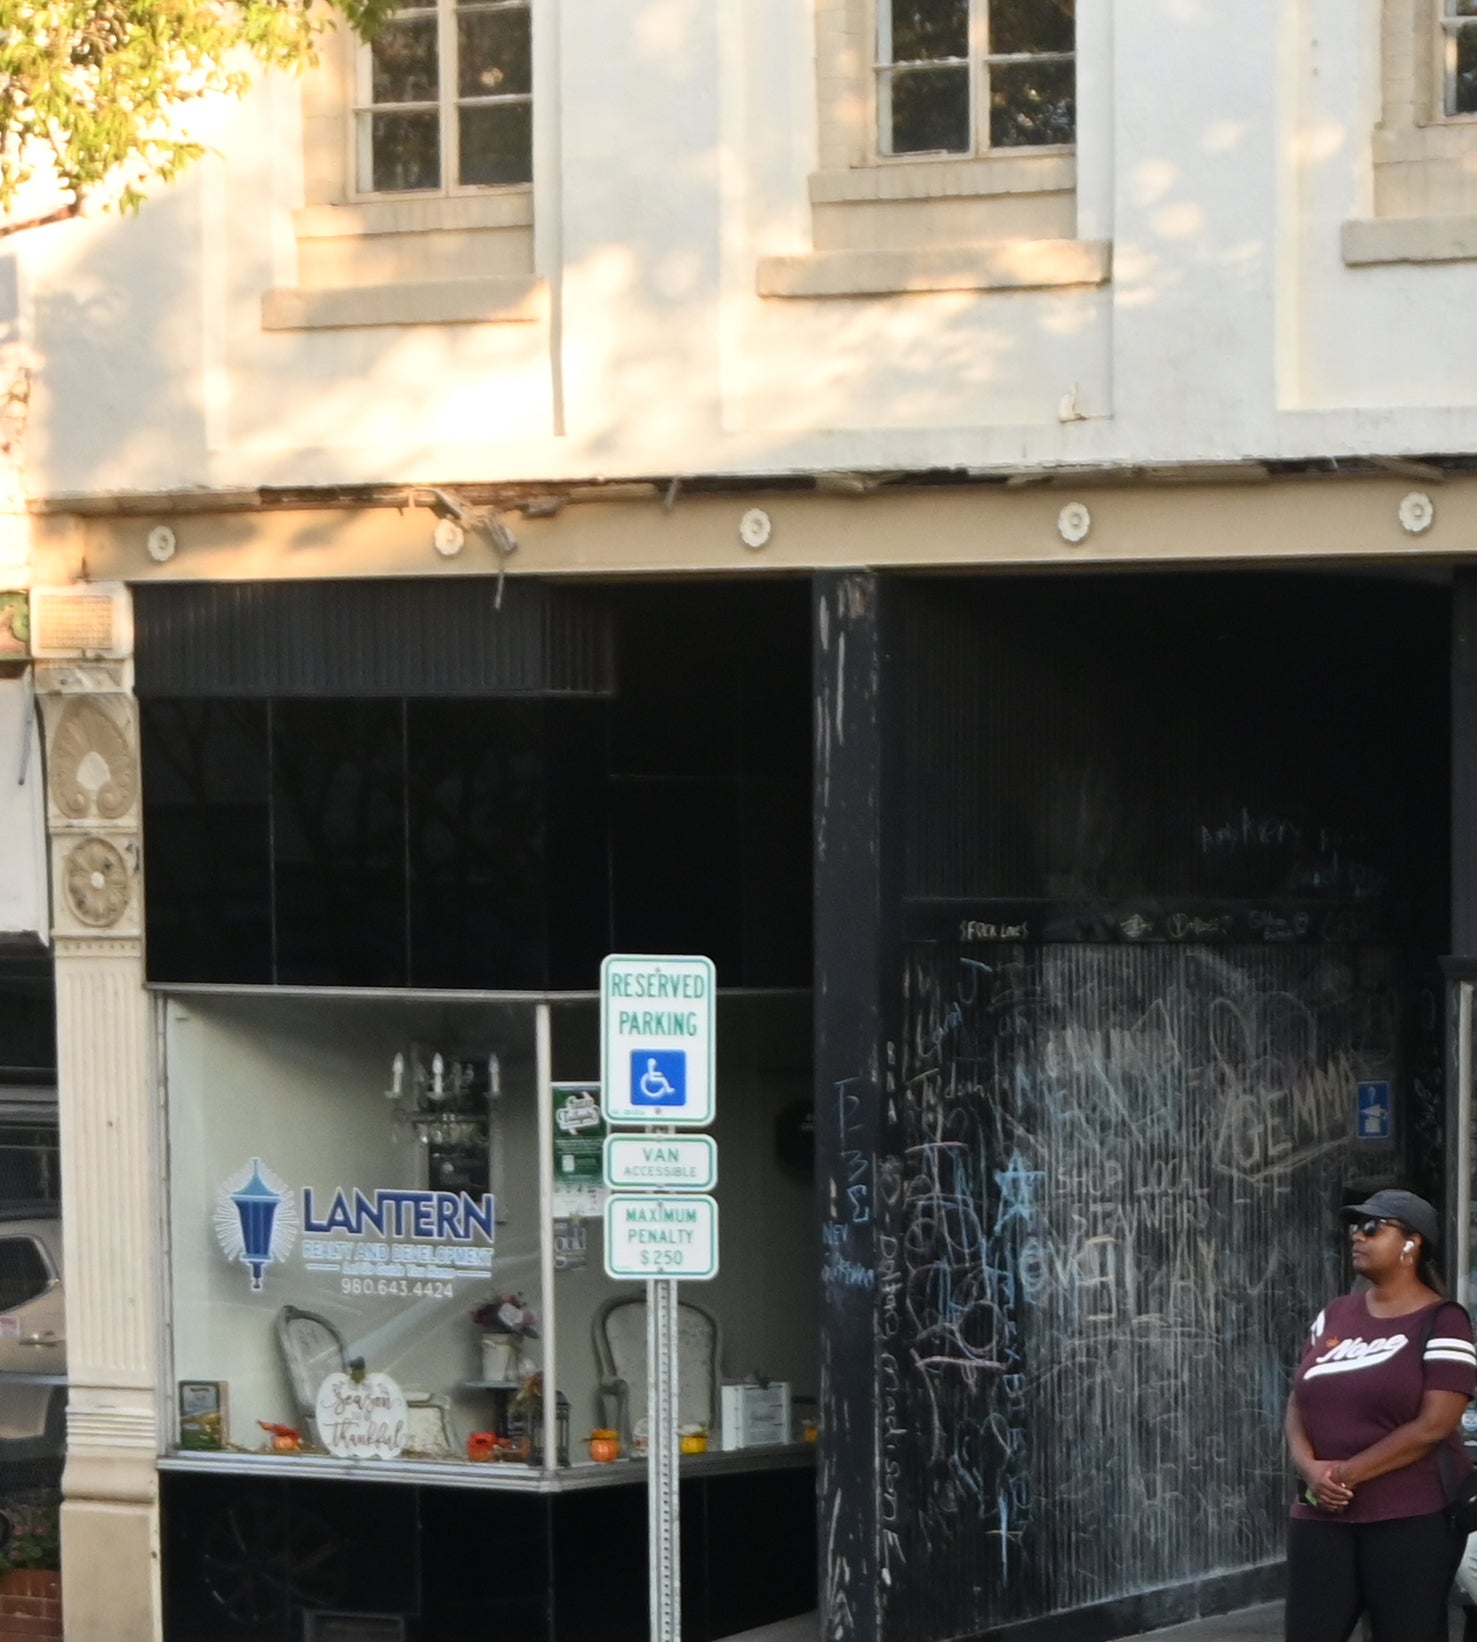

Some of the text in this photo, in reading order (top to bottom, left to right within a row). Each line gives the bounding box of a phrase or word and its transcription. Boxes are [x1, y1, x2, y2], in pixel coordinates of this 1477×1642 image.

[611, 973, 705, 999] RESERVED
[619, 1011, 698, 1037] PARKING
[642, 1148, 680, 1163] VAN
[624, 1166, 697, 1178] ACCESSIBLE
[302, 1186, 495, 1243] LANTERN
[625, 1208, 698, 1223] MAXIMUM
[627, 1229, 694, 1244] PENALTY
[640, 1249, 684, 1266] $250
[341, 1278, 454, 1298] 980.643.4424
[1315, 1333, 1409, 1364] Nope
